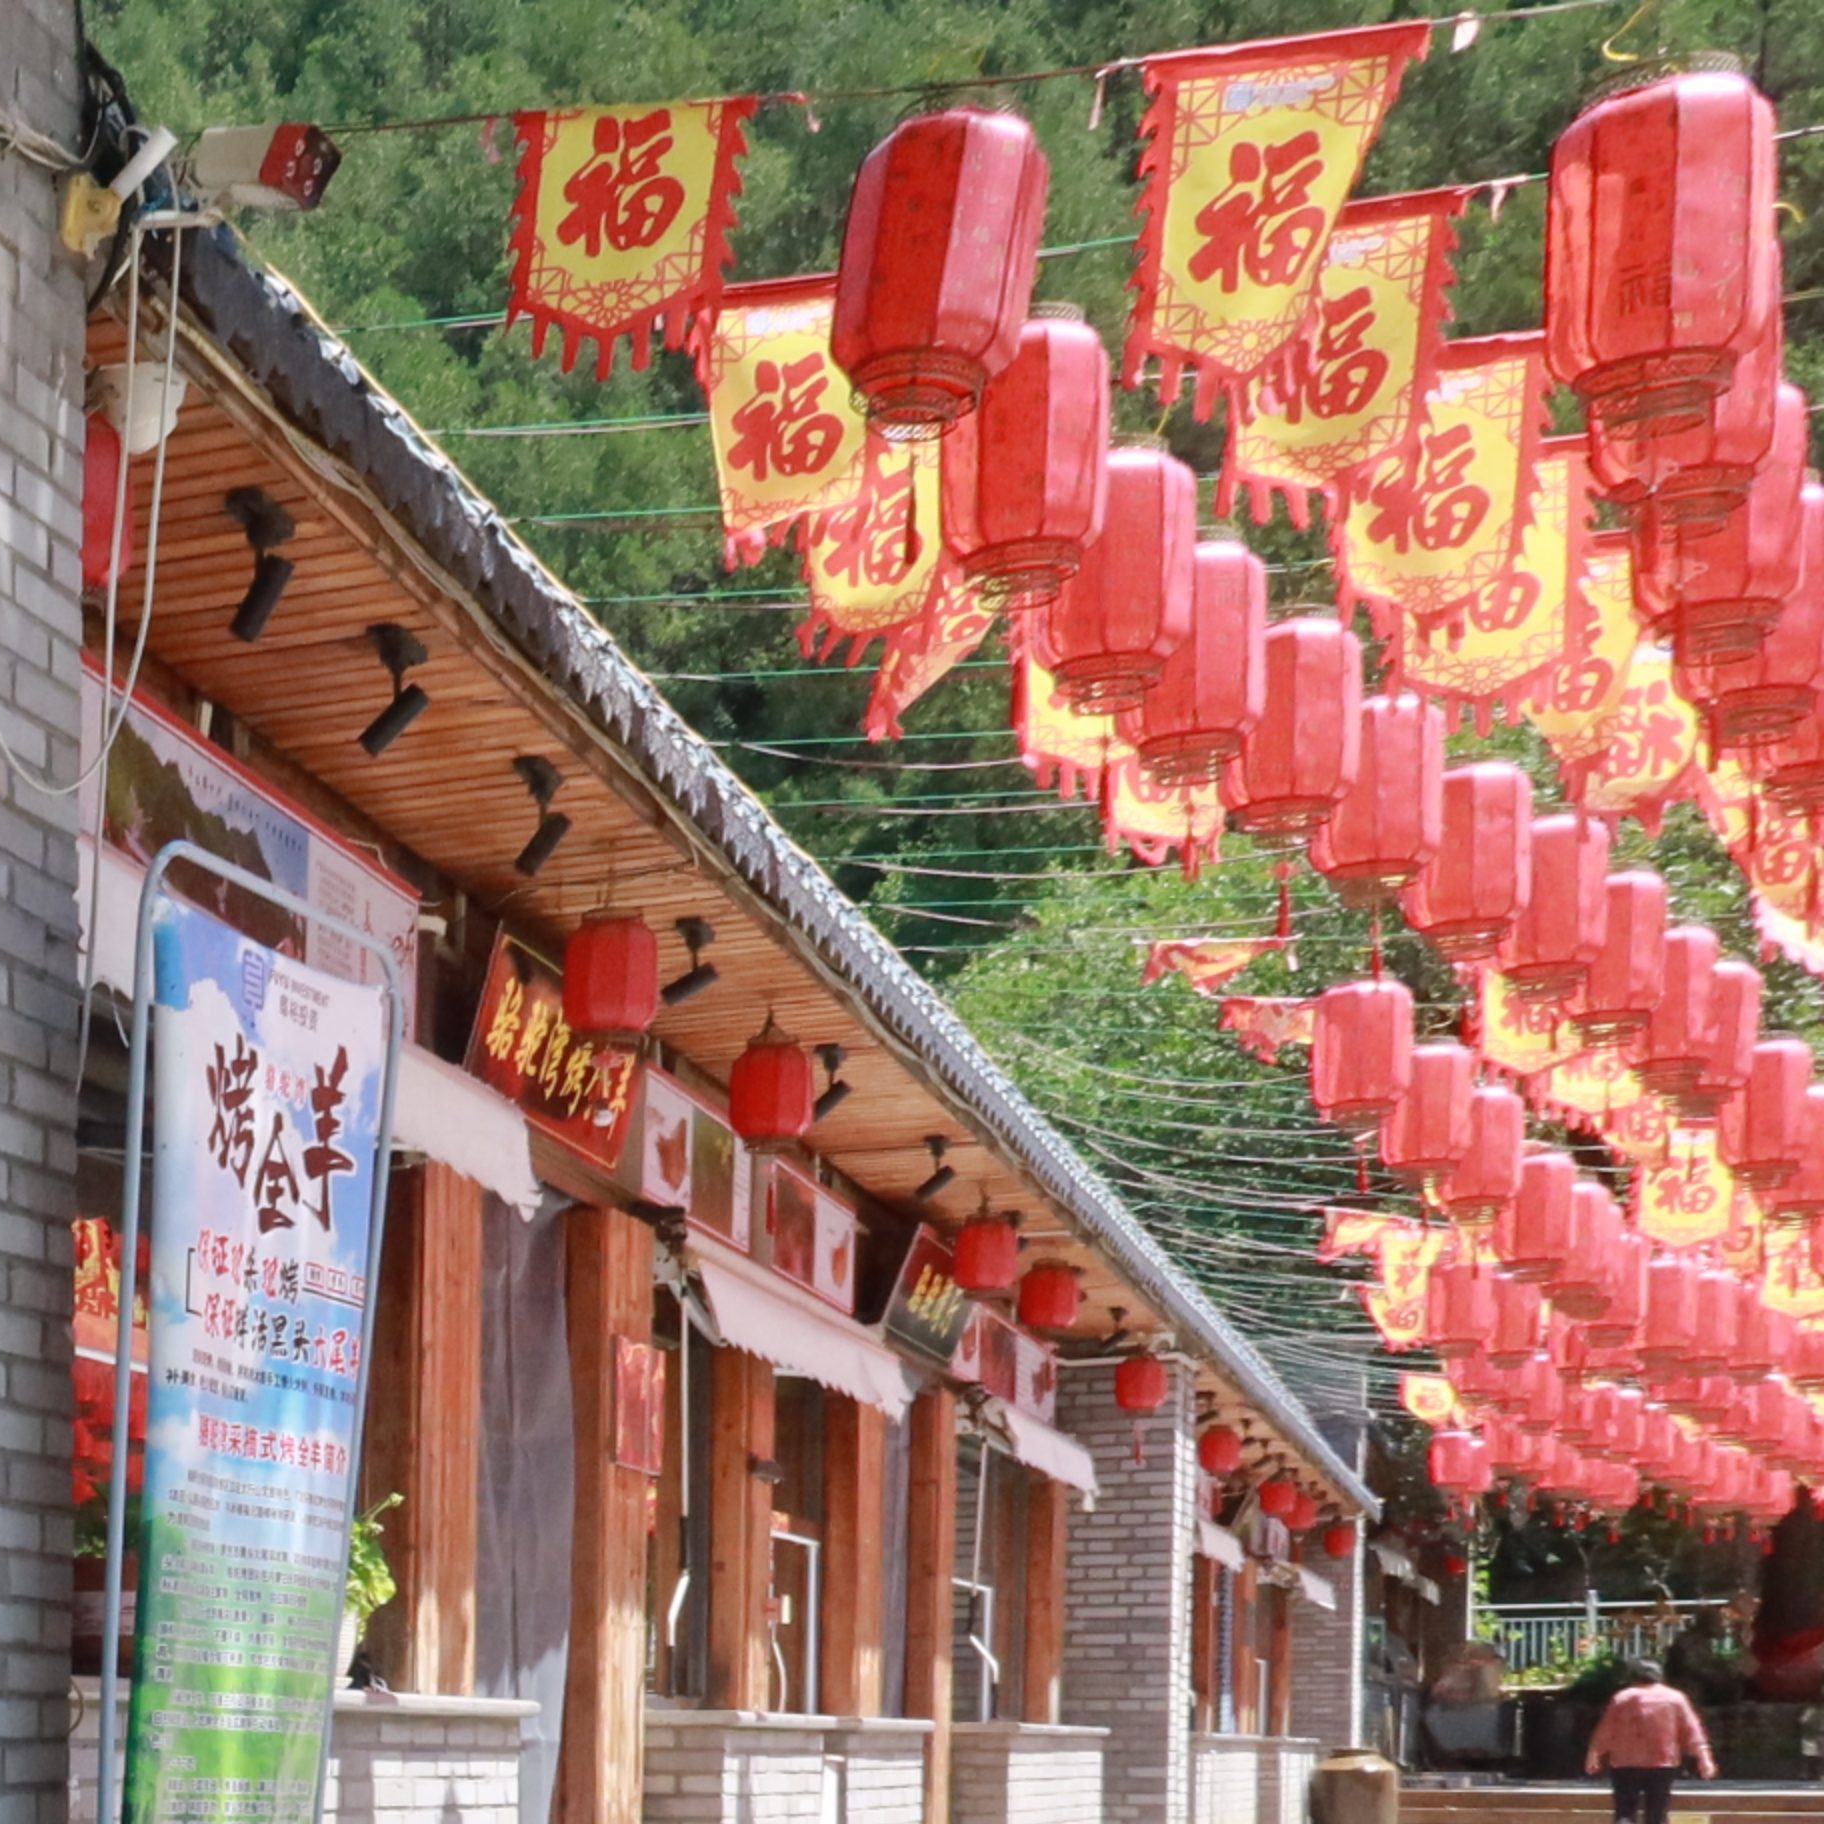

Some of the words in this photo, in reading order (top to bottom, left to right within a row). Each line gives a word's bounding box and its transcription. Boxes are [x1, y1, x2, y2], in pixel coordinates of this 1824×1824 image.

[557, 108, 685, 258] 福
[1188, 131, 1326, 293] 福
[726, 351, 844, 482] 福
[1257, 286, 1389, 425] 福
[1368, 423, 1490, 555] 福
[1650, 1155, 1718, 1214] 福
